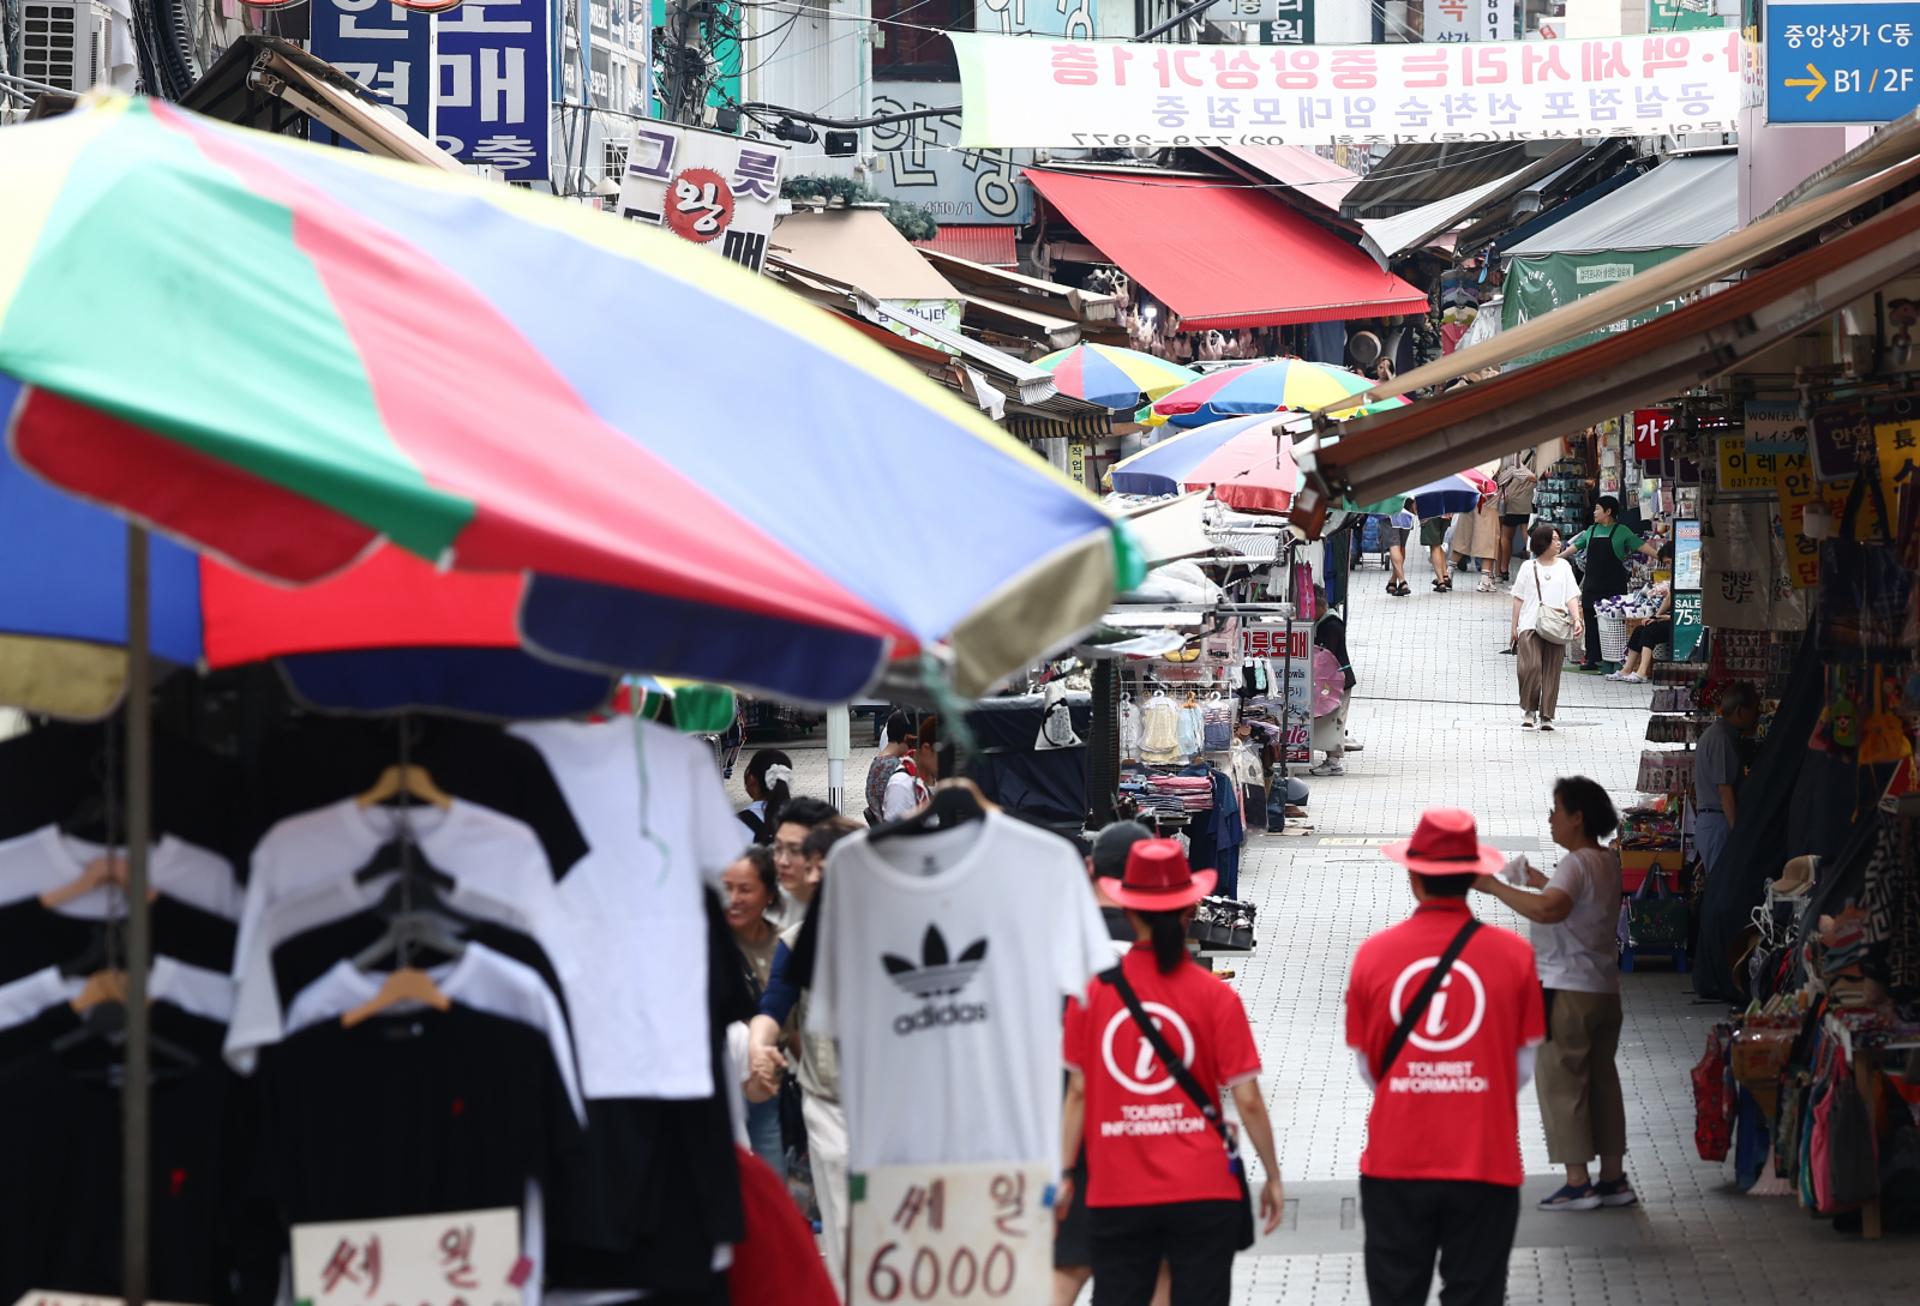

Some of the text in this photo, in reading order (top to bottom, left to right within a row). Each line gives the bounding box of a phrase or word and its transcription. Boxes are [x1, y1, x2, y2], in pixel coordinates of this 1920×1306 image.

[1784, 23, 1913, 49] 중앙상가 C동
[1834, 69, 1860, 93] B1
[1883, 68, 1914, 92] 2F
[1674, 599, 1701, 609] SALE
[893, 1002, 987, 1035] adidas
[1407, 1061, 1474, 1078] TOURIST
[1389, 1076, 1488, 1094] INFORMATIO
[1121, 1103, 1184, 1120] TOURIST
[1101, 1117, 1205, 1137] INFORMATION
[868, 1241, 1016, 1302] 6000
